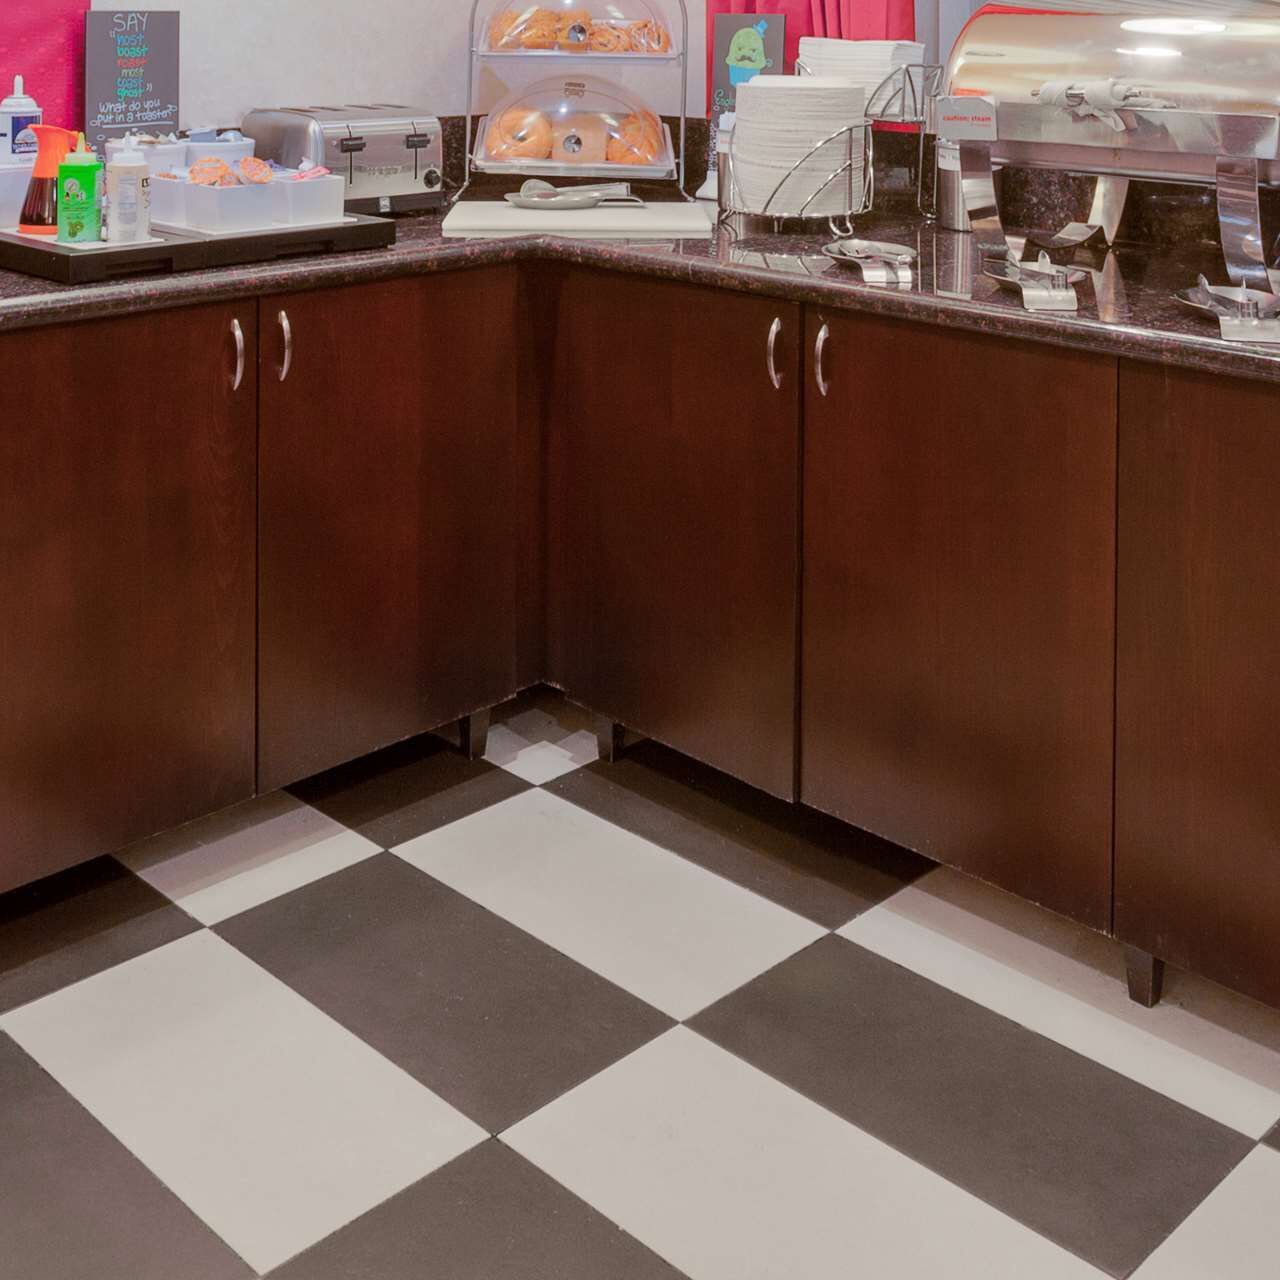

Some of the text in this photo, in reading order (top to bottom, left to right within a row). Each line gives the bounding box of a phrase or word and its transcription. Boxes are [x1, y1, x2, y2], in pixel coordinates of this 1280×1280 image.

[112, 12, 148, 33] SAY
[129, 100, 141, 111] do
[144, 99, 160, 112] you
[115, 113, 125, 122] in
[127, 112, 134, 122] a
